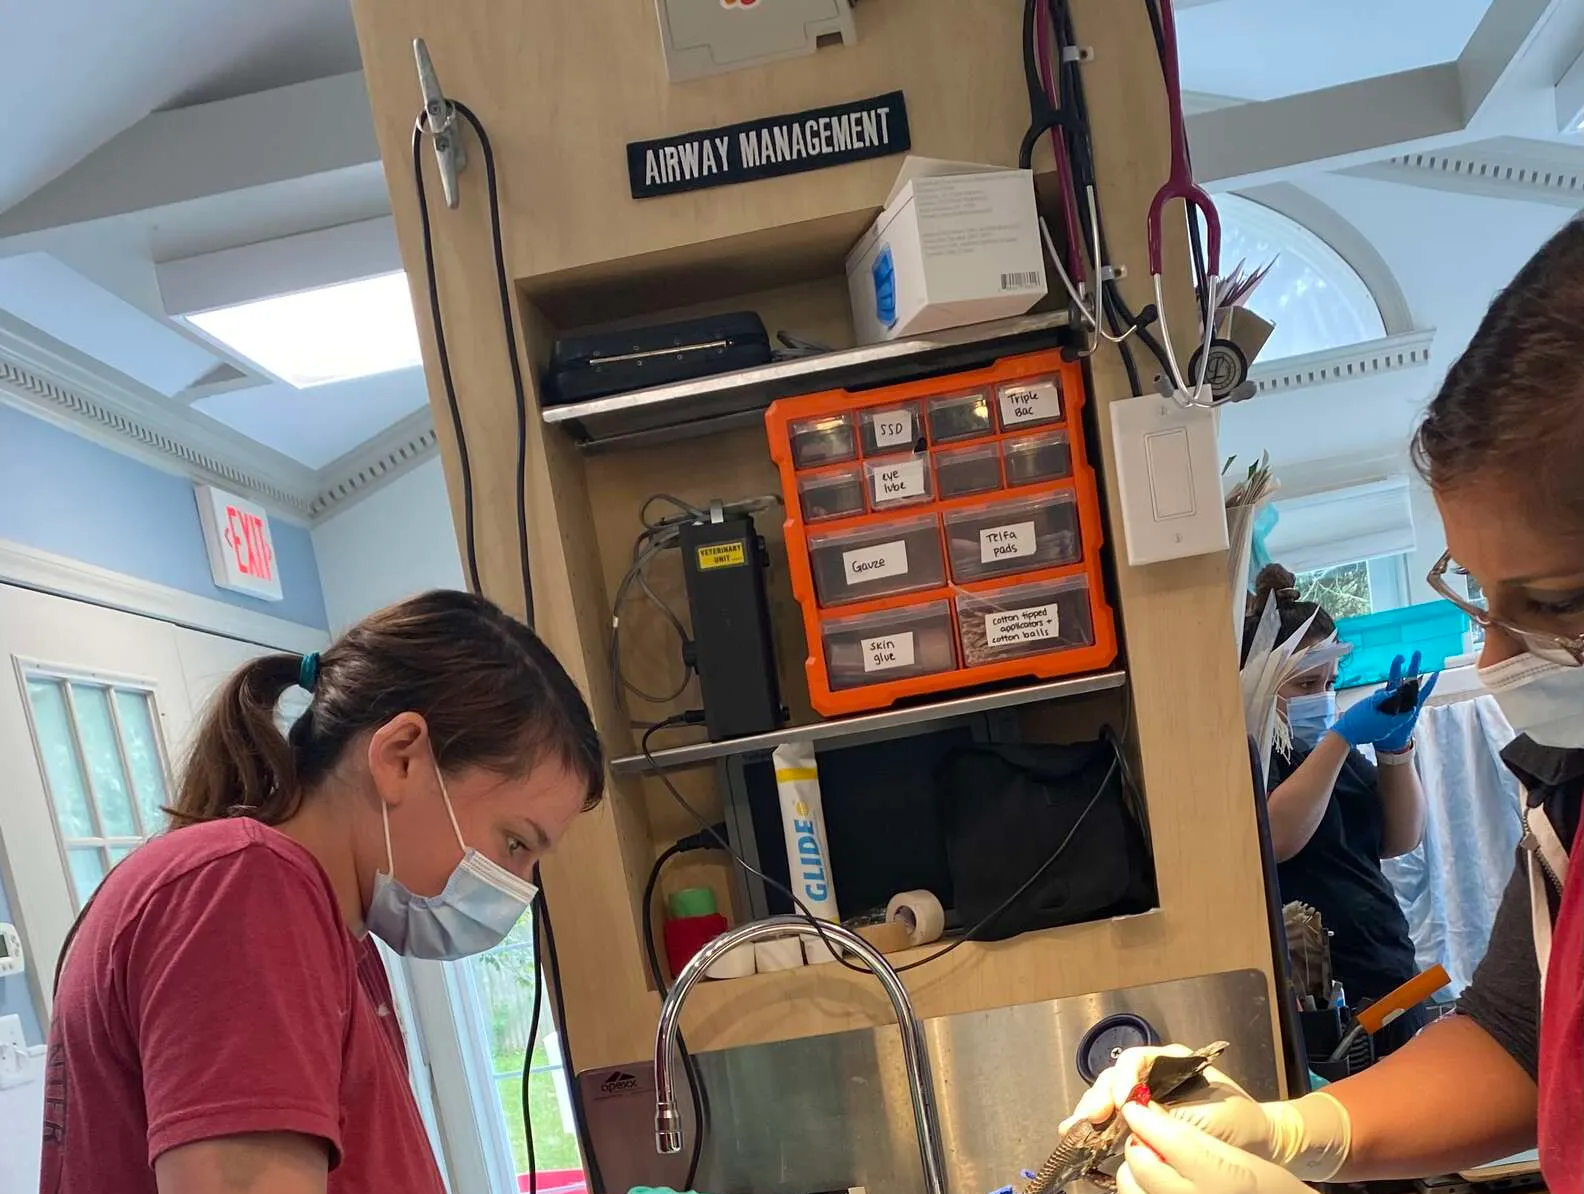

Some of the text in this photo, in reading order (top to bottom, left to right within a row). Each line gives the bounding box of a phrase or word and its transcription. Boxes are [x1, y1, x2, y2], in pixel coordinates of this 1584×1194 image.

[645, 107, 890, 186] AIRWAY MANAGEMENT
[1007, 391, 1039, 405] Triple
[880, 422, 903, 436] SSD
[882, 469, 900, 482] eye
[883, 480, 907, 494] lube
[226, 504, 272, 582] EXIT
[700, 544, 741, 557] VETERINARY
[993, 543, 1018, 558] pads
[851, 557, 886, 574] Gauze
[1022, 608, 1048, 621] tipped
[1000, 620, 1044, 633] applicators
[1023, 628, 1049, 639] balls
[873, 651, 896, 666] glue
[793, 819, 828, 902] GLIDE
